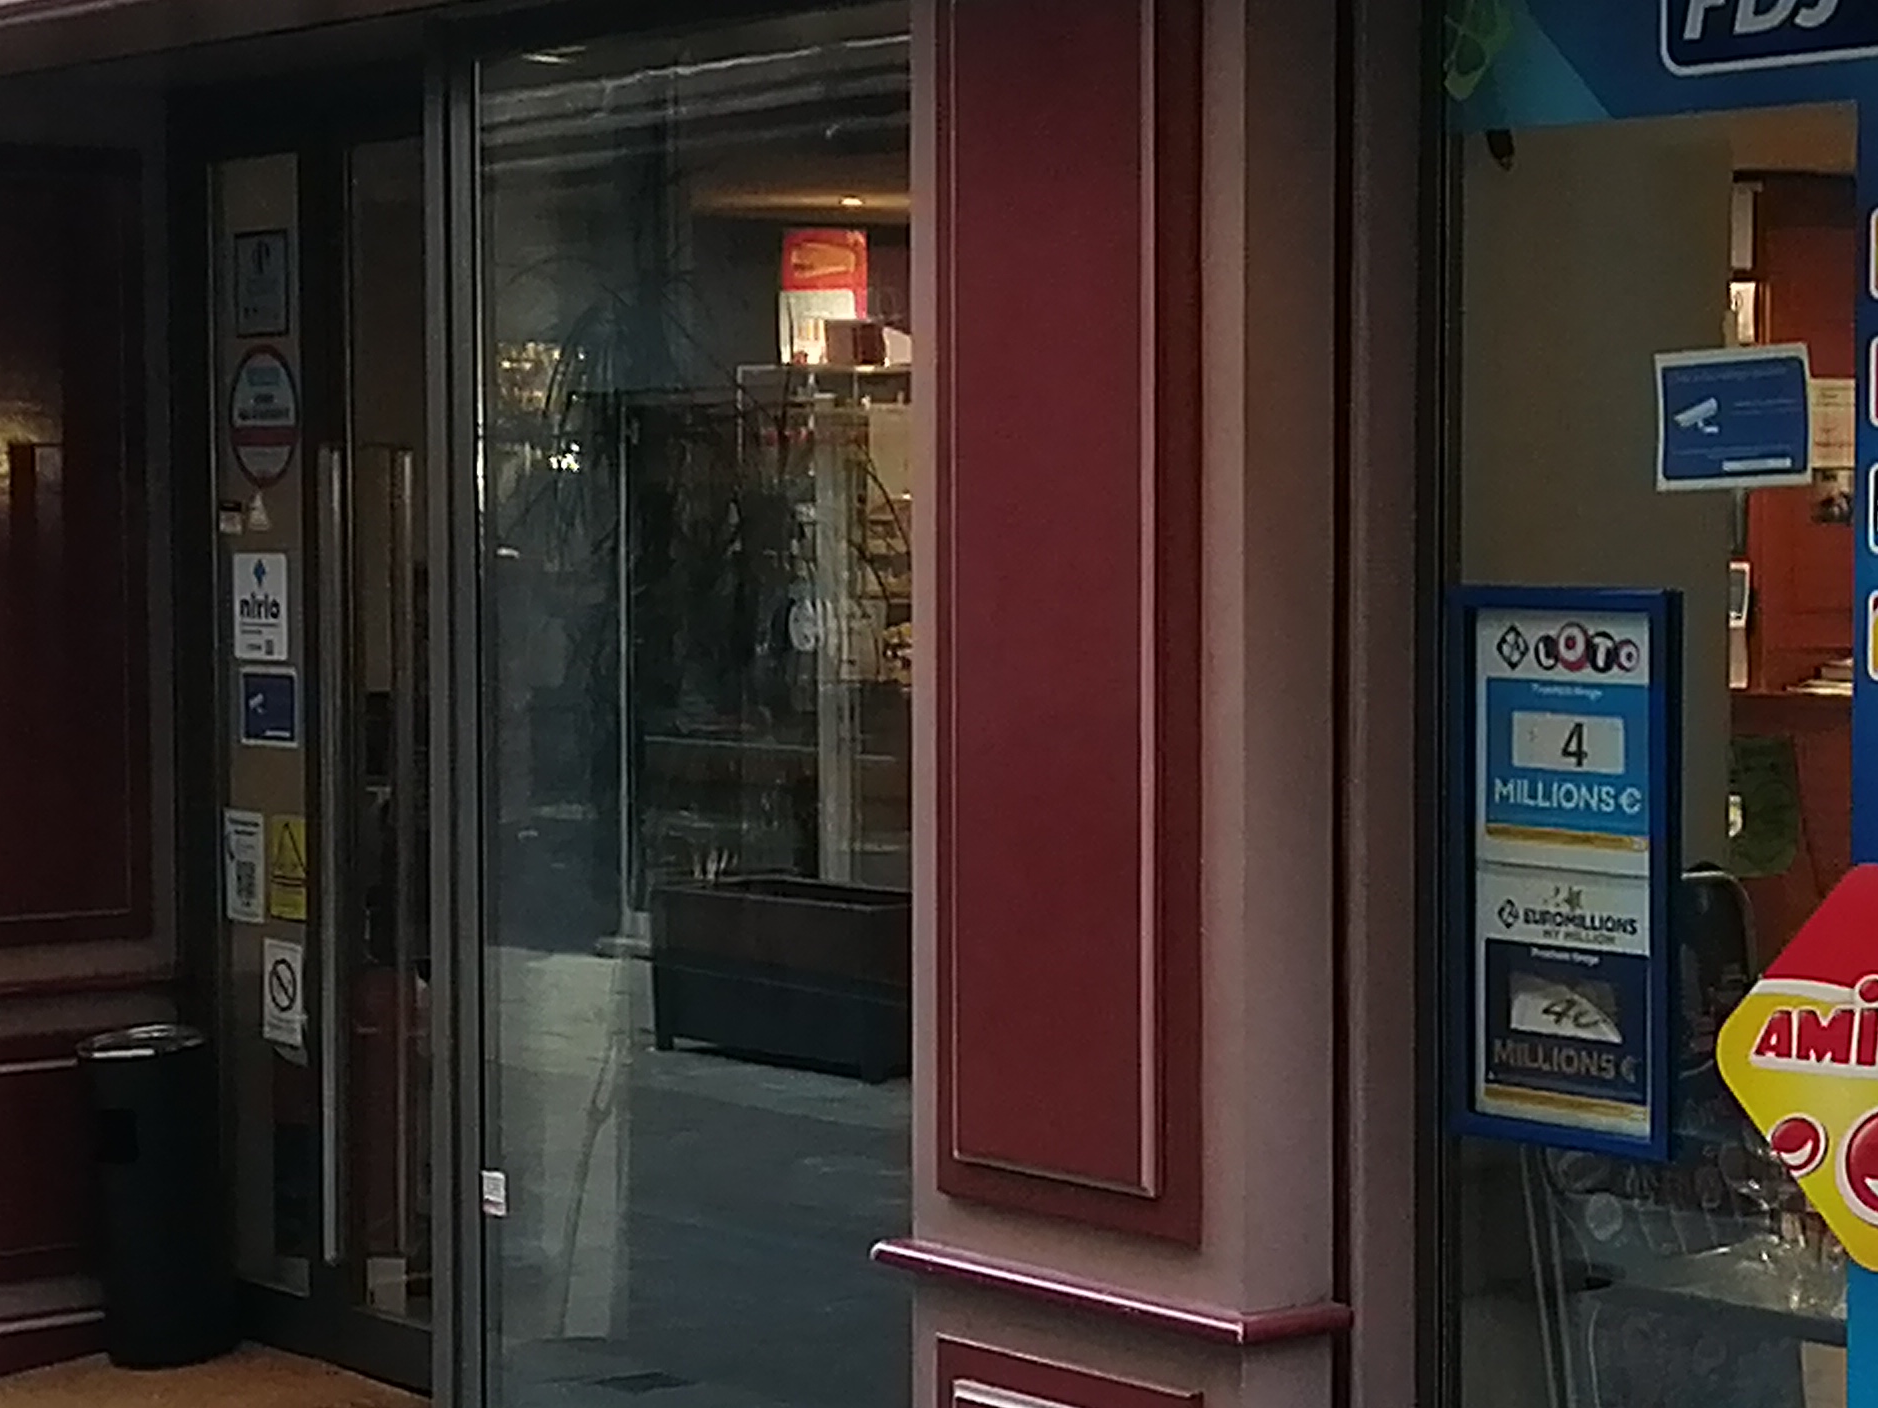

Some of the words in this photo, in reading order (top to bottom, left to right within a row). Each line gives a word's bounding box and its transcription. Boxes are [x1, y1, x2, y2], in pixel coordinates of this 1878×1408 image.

[1536, 622, 1640, 672] LOTO
[1561, 721, 1588, 768] 4
[1493, 778, 1615, 813] MILLIONS
[1523, 907, 1638, 935] EUROMILLIONS
[1493, 1038, 1615, 1078] MILLIONS
